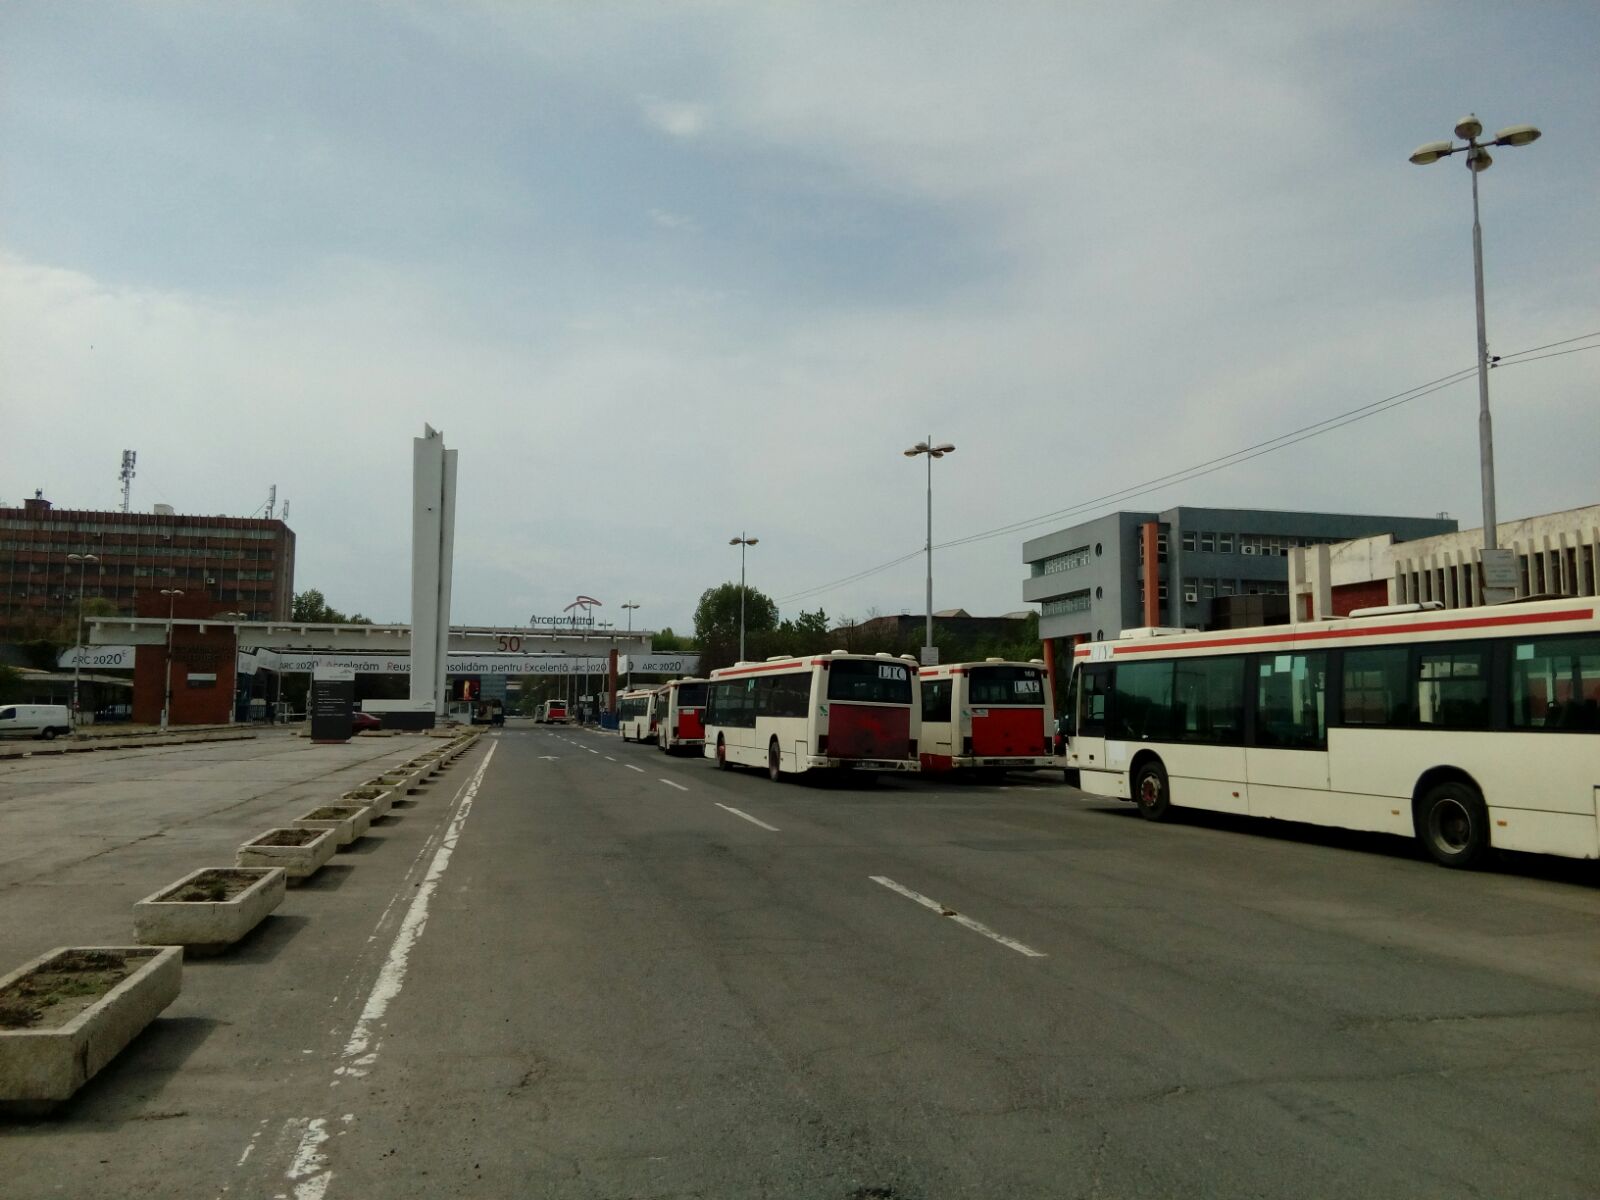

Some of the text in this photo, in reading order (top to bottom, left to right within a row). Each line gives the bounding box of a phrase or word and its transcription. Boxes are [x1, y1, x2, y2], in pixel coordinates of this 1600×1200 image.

[529, 615, 595, 626] ArcelorMittal
[497, 636, 521, 652] 50
[72, 656, 91, 665] ARC
[93, 653, 122, 665] 2020
[279, 662, 295, 670] ARC
[386, 662, 412, 672] Reus
[491, 663, 522, 674] pentru
[642, 663, 658, 671] ARC
[659, 661, 682, 672] 2020
